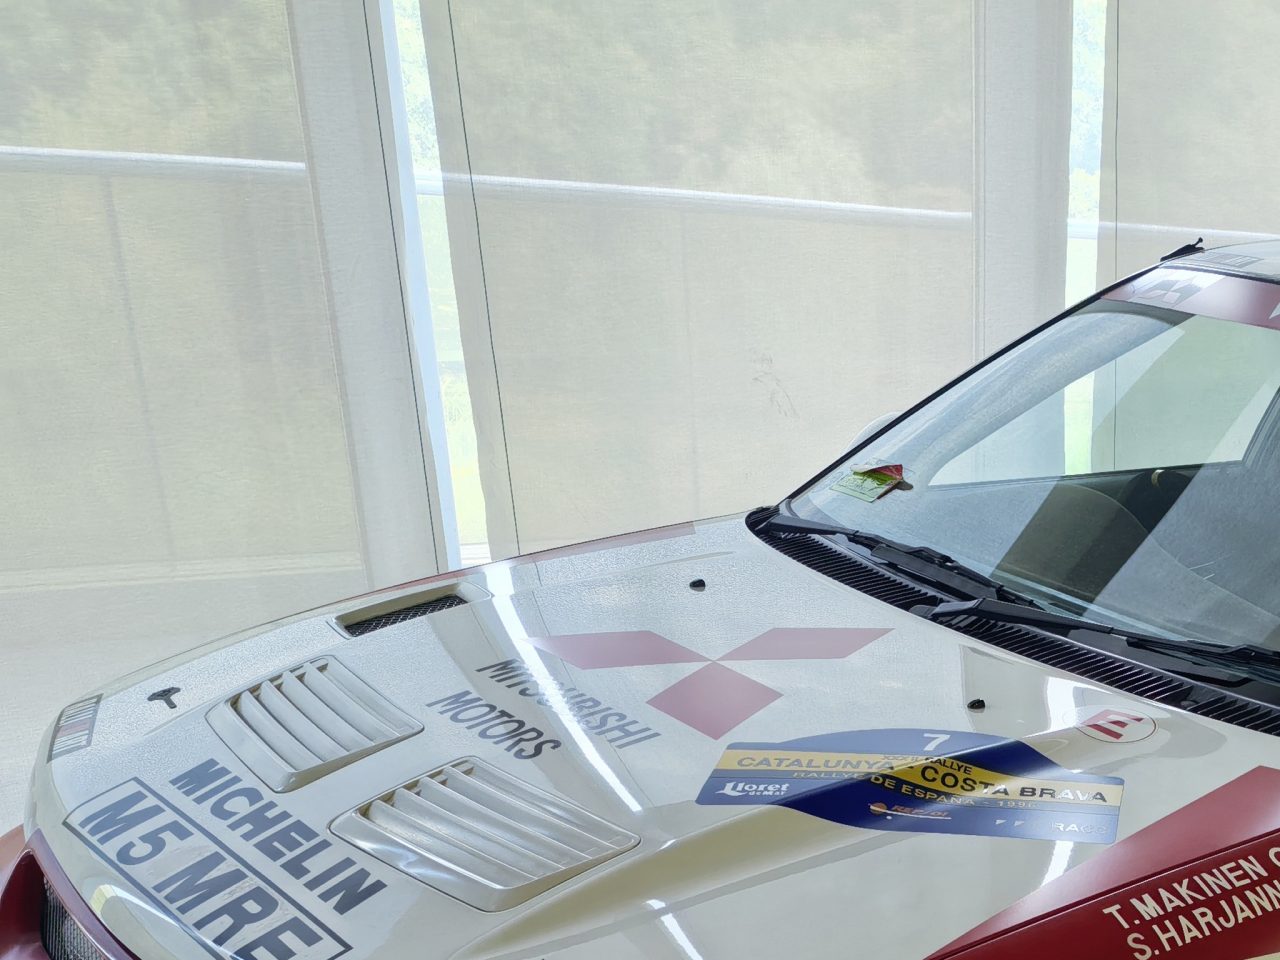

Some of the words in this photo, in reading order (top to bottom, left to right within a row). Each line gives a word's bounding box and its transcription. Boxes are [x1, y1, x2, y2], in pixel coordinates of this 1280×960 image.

[426, 690, 562, 760] MOTORS
[921, 733, 951, 751] 7
[736, 757, 894, 771] CATALUNYA
[920, 765, 1009, 797] COSTA
[1019, 786, 1108, 803] BRAVA
[870, 775, 896, 789] DE
[78, 791, 191, 867] M5
[168, 758, 388, 916] MICHELIN
